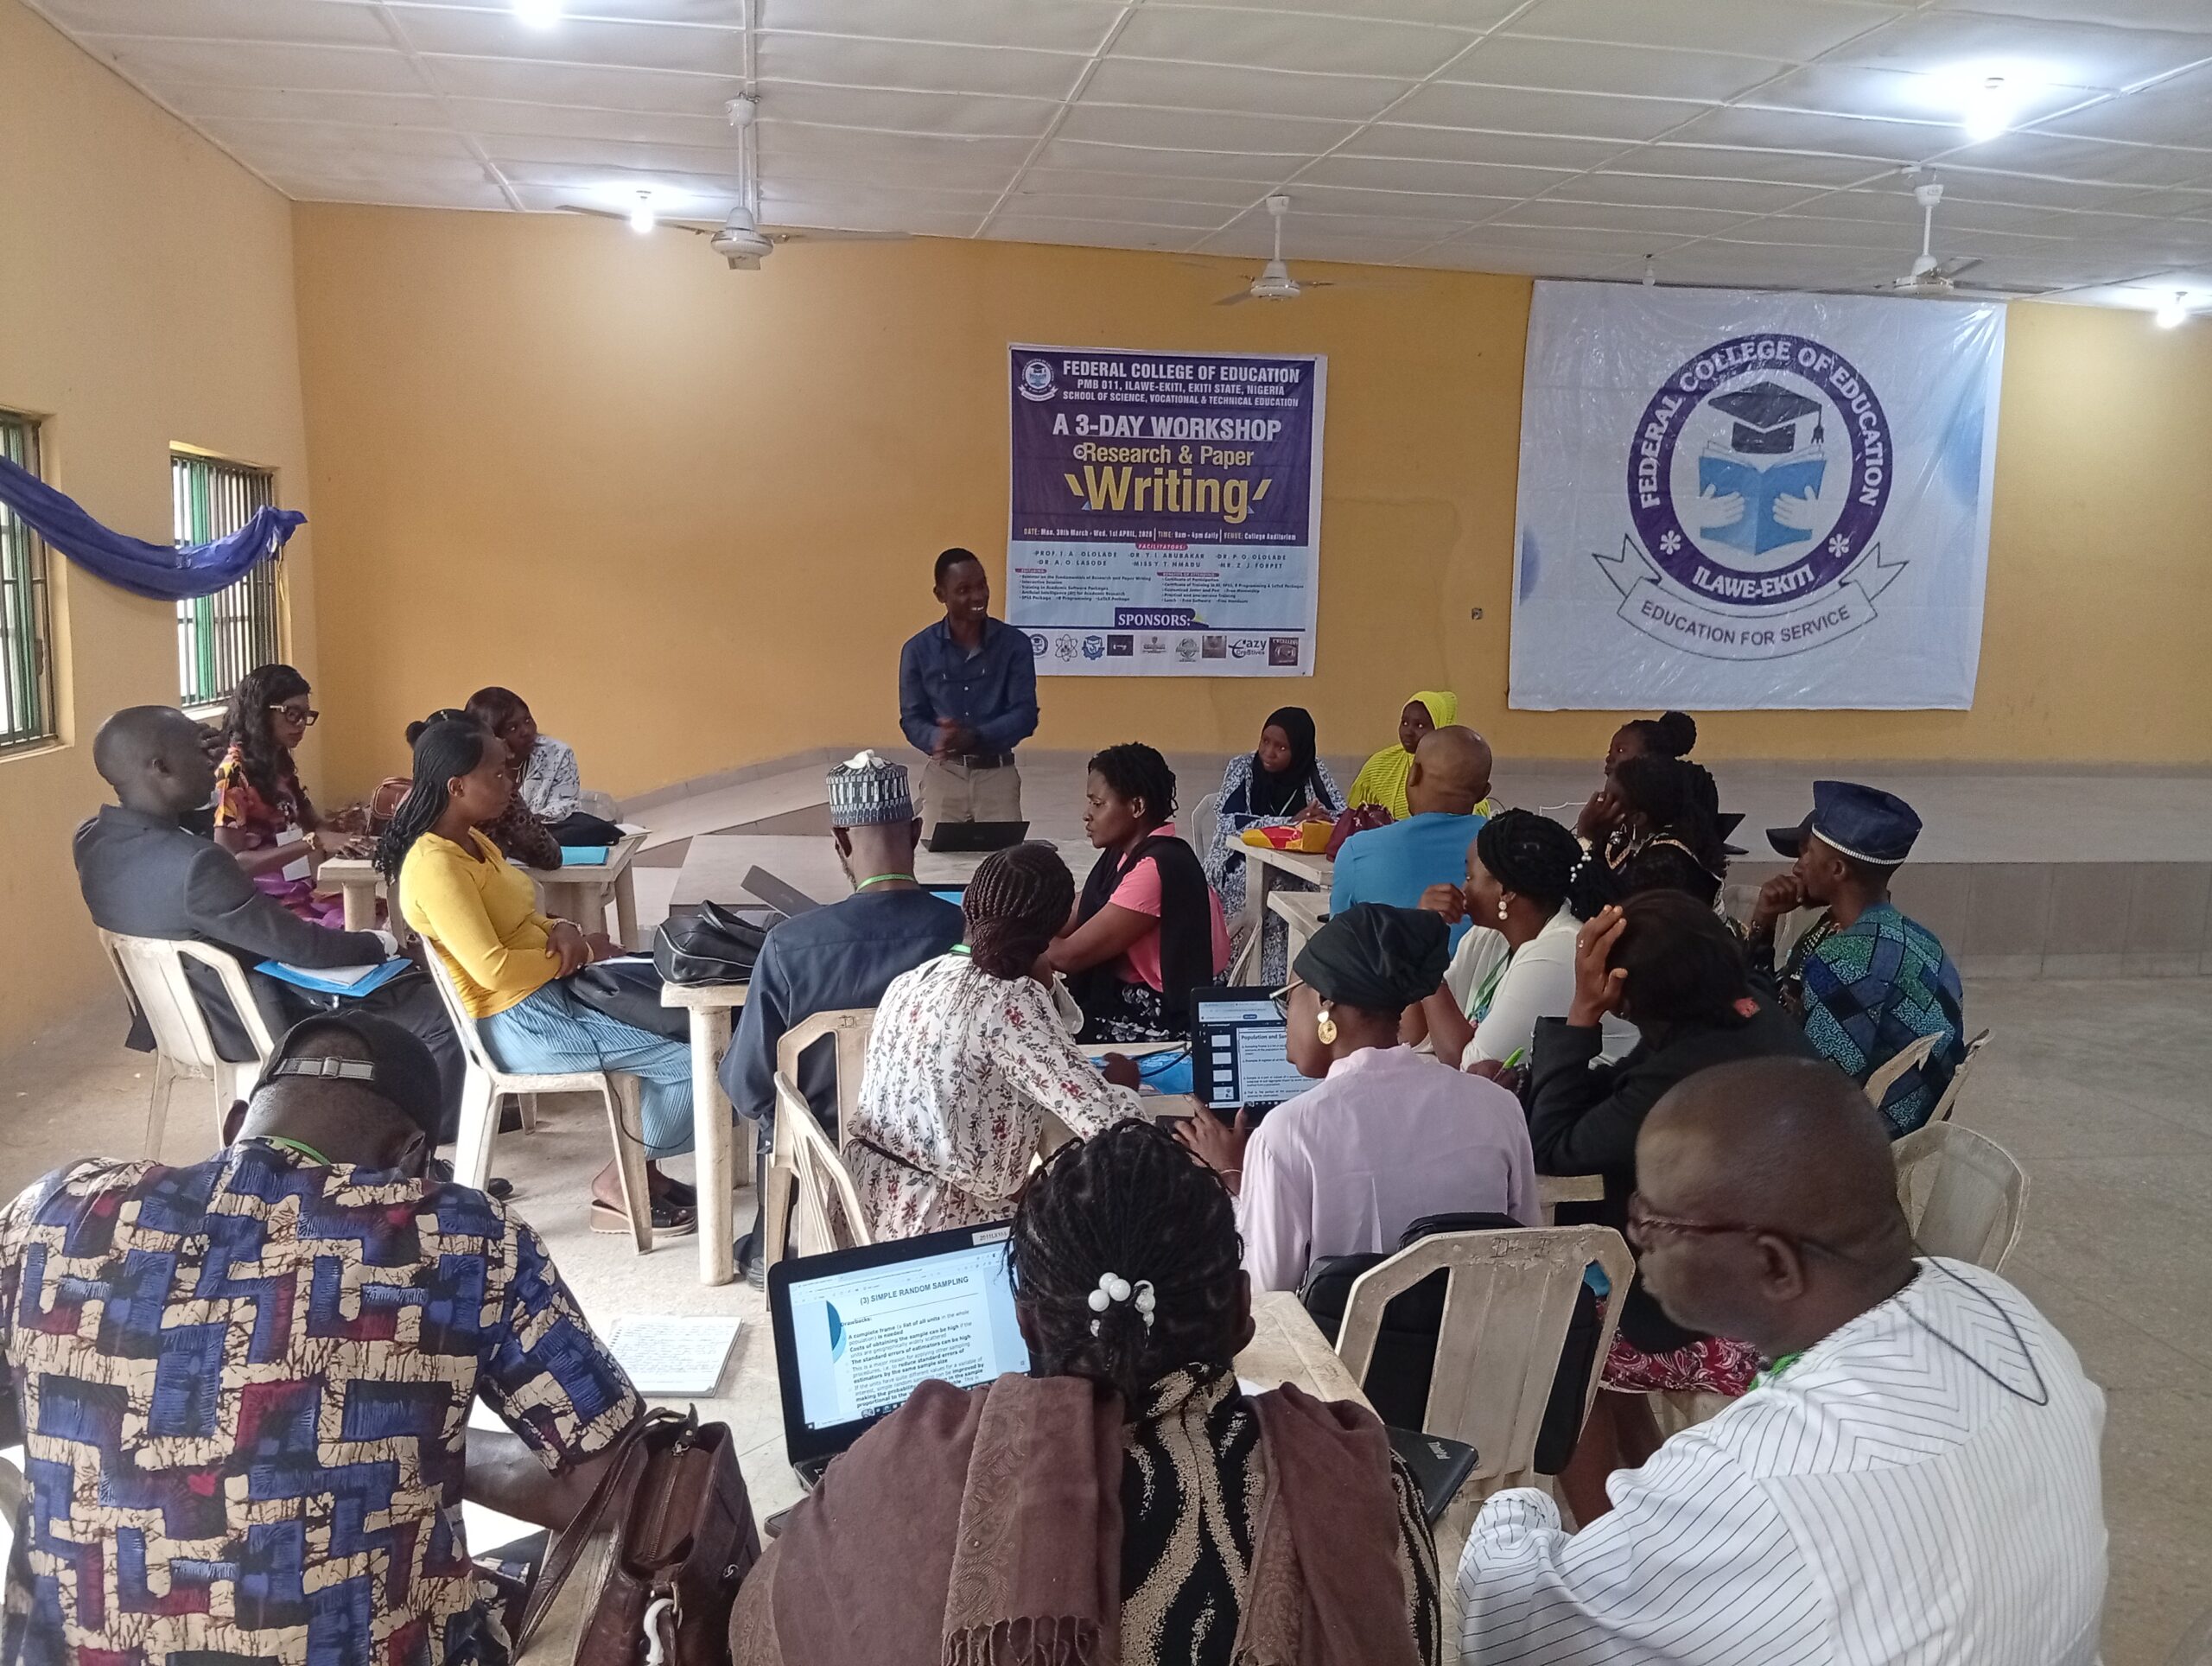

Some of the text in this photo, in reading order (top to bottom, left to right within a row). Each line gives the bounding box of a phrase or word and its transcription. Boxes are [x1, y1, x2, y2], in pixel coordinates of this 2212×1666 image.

[1063, 360, 1127, 378] FEDERAL
[1131, 363, 1193, 380] COLLEGE
[1198, 365, 1216, 381] OF
[1220, 366, 1300, 383] EDUCATION
[1063, 391, 1096, 401] SCHOOL
[1097, 392, 1108, 401] OF
[1110, 392, 1147, 404] SCIENCE,
[1150, 394, 1199, 404] VOCATIONAL
[1209, 396, 1252, 405] TECHNICAL
[1255, 397, 1299, 407] EDUCATION
[1077, 379, 1285, 396] PMB 011, ILAWE-EKITI, EKITI STATE, NIGERIA
[1052, 413, 1282, 441] A 3-DAY WORKSHOP
[1638, 340, 1885, 510] FEDERAL COLLEGE OF EDUCATION
[1083, 442, 1255, 469] Research & Paper
[1083, 465, 1249, 525] Writing
[1244, 532, 1265, 542] College
[1267, 533, 1296, 542] Auditorium
[1692, 563, 1816, 598] ILAWE-EKITI
[1118, 614, 1191, 626] SPONSORS:
[1640, 600, 1851, 645] EDUCATION FOR SERVICE
[860, 1275, 969, 1306] (3) SIMPLE RANDOM SAMPLING
[863, 1352, 886, 1361] standard
